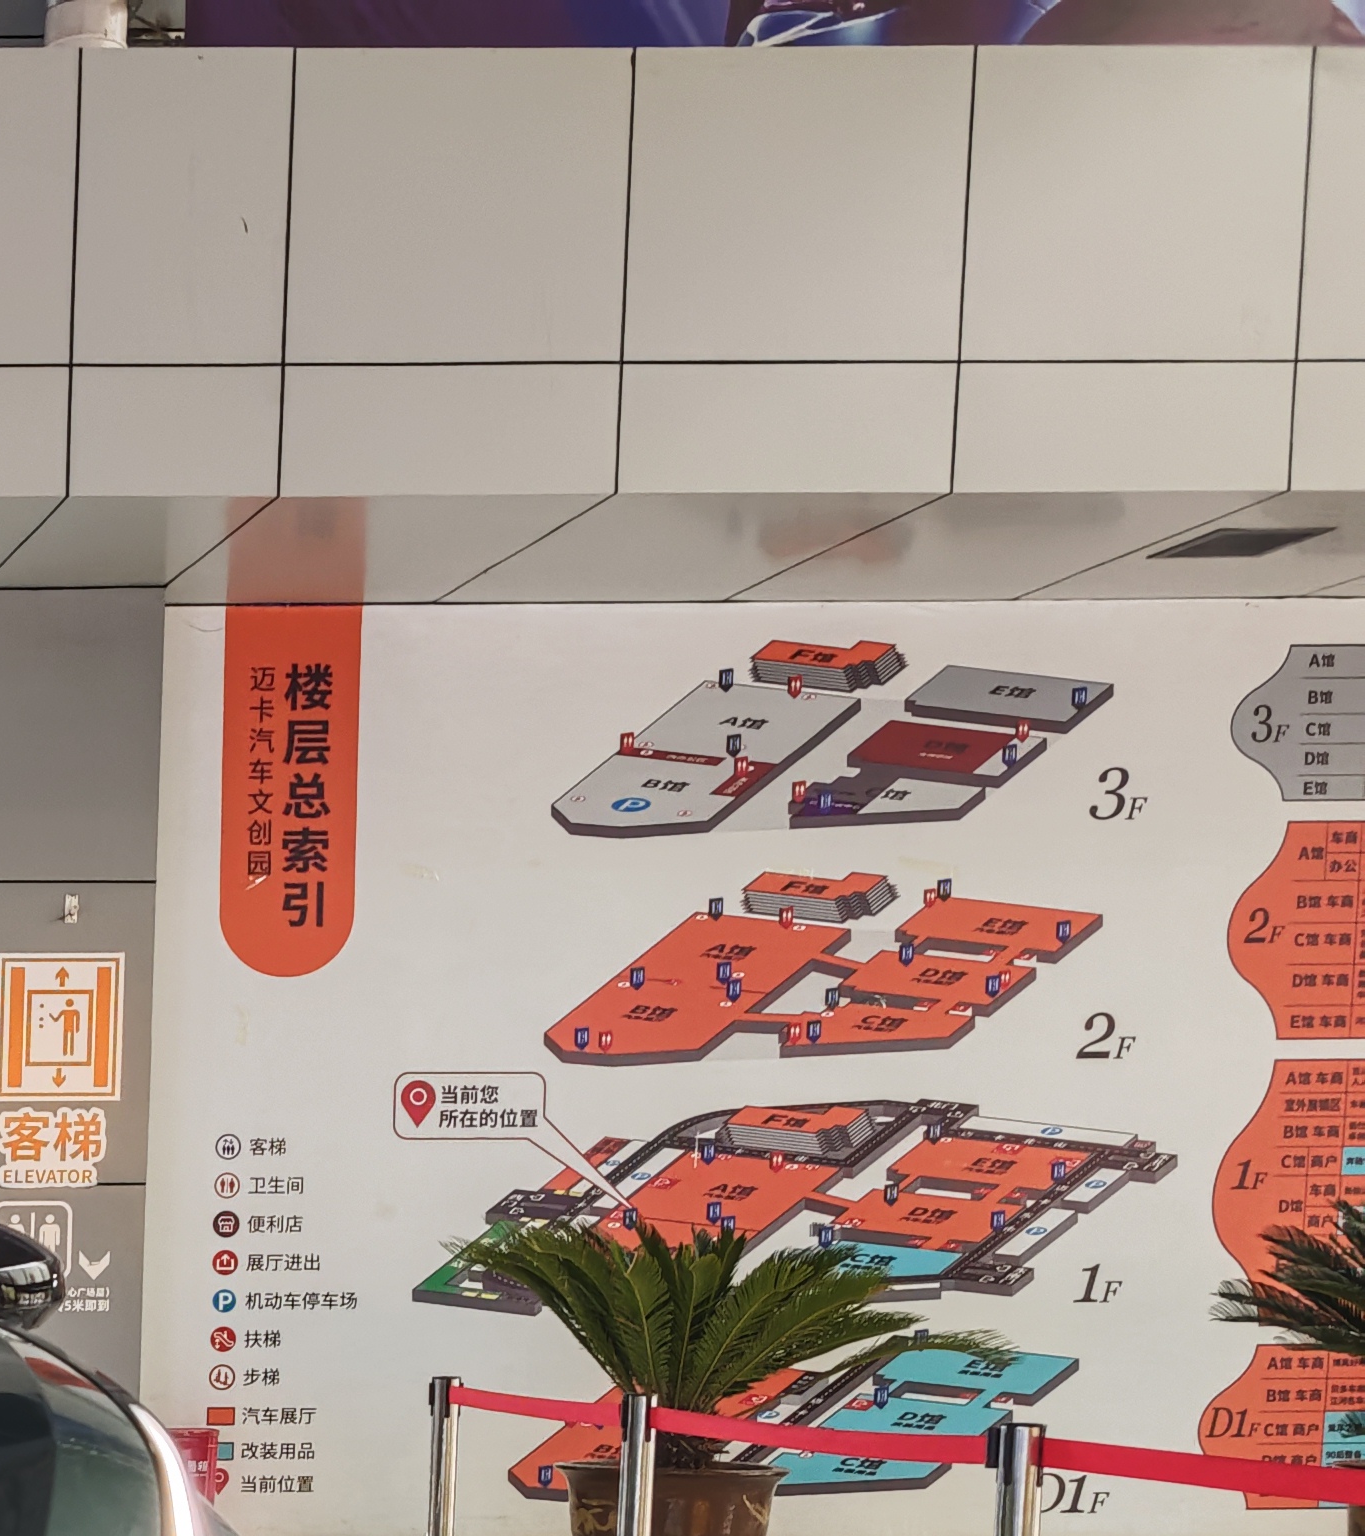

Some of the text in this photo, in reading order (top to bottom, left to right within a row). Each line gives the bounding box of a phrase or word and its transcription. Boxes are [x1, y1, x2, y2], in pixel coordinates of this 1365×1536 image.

[1309, 653, 1336, 668] A馆
[988, 684, 1038, 699] E馆
[1307, 690, 1334, 705] B馆
[718, 716, 770, 730] A馆
[1251, 704, 1290, 744] 3F
[1305, 722, 1331, 737] C馆
[1304, 751, 1330, 766] D馆
[247, 665, 275, 878] 迈卡汽车文创园
[641, 778, 690, 793] B馆
[1088, 766, 1148, 820] 3F
[1302, 781, 1329, 796] E馆
[282, 662, 333, 928] 楼层总索引
[1297, 846, 1325, 860] A馆
[1296, 895, 1322, 909] B馆
[1243, 906, 1286, 945] 2F
[1294, 933, 1320, 947] C馆
[1291, 973, 1317, 988] D馆
[1290, 1015, 1315, 1028] E馆
[1076, 1012, 1137, 1060] 2F
[1285, 1071, 1311, 1086] A馆
[440, 1085, 500, 1105] 当前您
[438, 1108, 539, 1129] 所在的位置
[2, 1111, 105, 1163] 客梯
[1283, 1125, 1309, 1139] B馆
[249, 1137, 287, 1157] 客梯
[1281, 1154, 1307, 1168] C馆
[3, 1168, 94, 1185] ELEVATOR
[1230, 1159, 1268, 1191] 1F
[248, 1176, 305, 1196] 卫生间
[1278, 1199, 1304, 1213] D馆
[247, 1215, 304, 1234] 便利店
[246, 1254, 321, 1273] 展厅进出
[1072, 1263, 1124, 1303] 1F
[245, 1292, 358, 1311] 机动车停车场
[244, 1329, 282, 1349] 扶梯
[1266, 1356, 1294, 1370] A馆
[242, 1367, 280, 1386] 步梯
[1266, 1388, 1291, 1402] B馆
[242, 1407, 317, 1425] 汽车展厅
[1205, 1406, 1261, 1439] D1F
[1263, 1422, 1289, 1437] C馆
[240, 1441, 316, 1460] 改装用品
[240, 1475, 314, 1494] 当前位置
